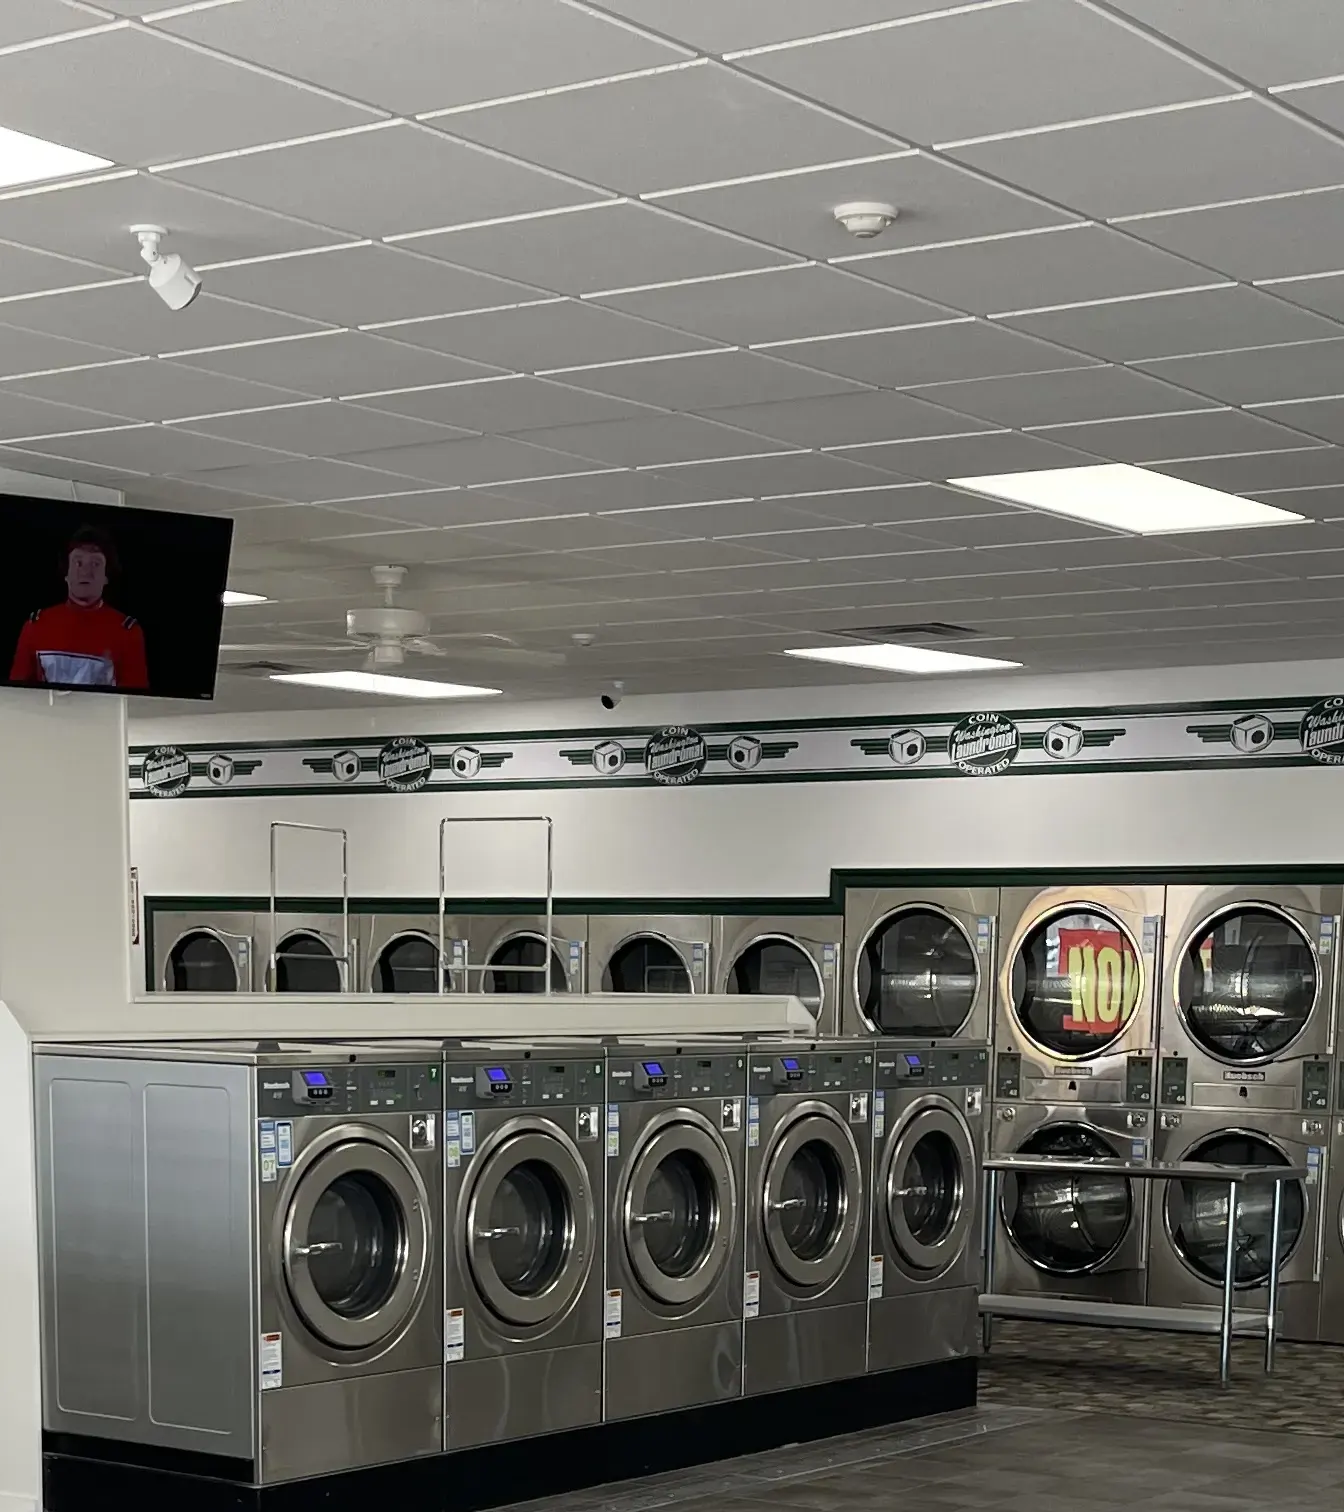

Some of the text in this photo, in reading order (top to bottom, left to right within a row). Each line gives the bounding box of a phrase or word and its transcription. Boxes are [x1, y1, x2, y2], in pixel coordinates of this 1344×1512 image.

[969, 714, 999, 724] COIN
[662, 727, 688, 736] COIN
[954, 723, 1010, 742] Washington
[393, 738, 416, 746] COIN
[952, 729, 1016, 763] Laundromat
[959, 758, 1009, 774] OPERATED
[263, 1159, 275, 1171] 07
